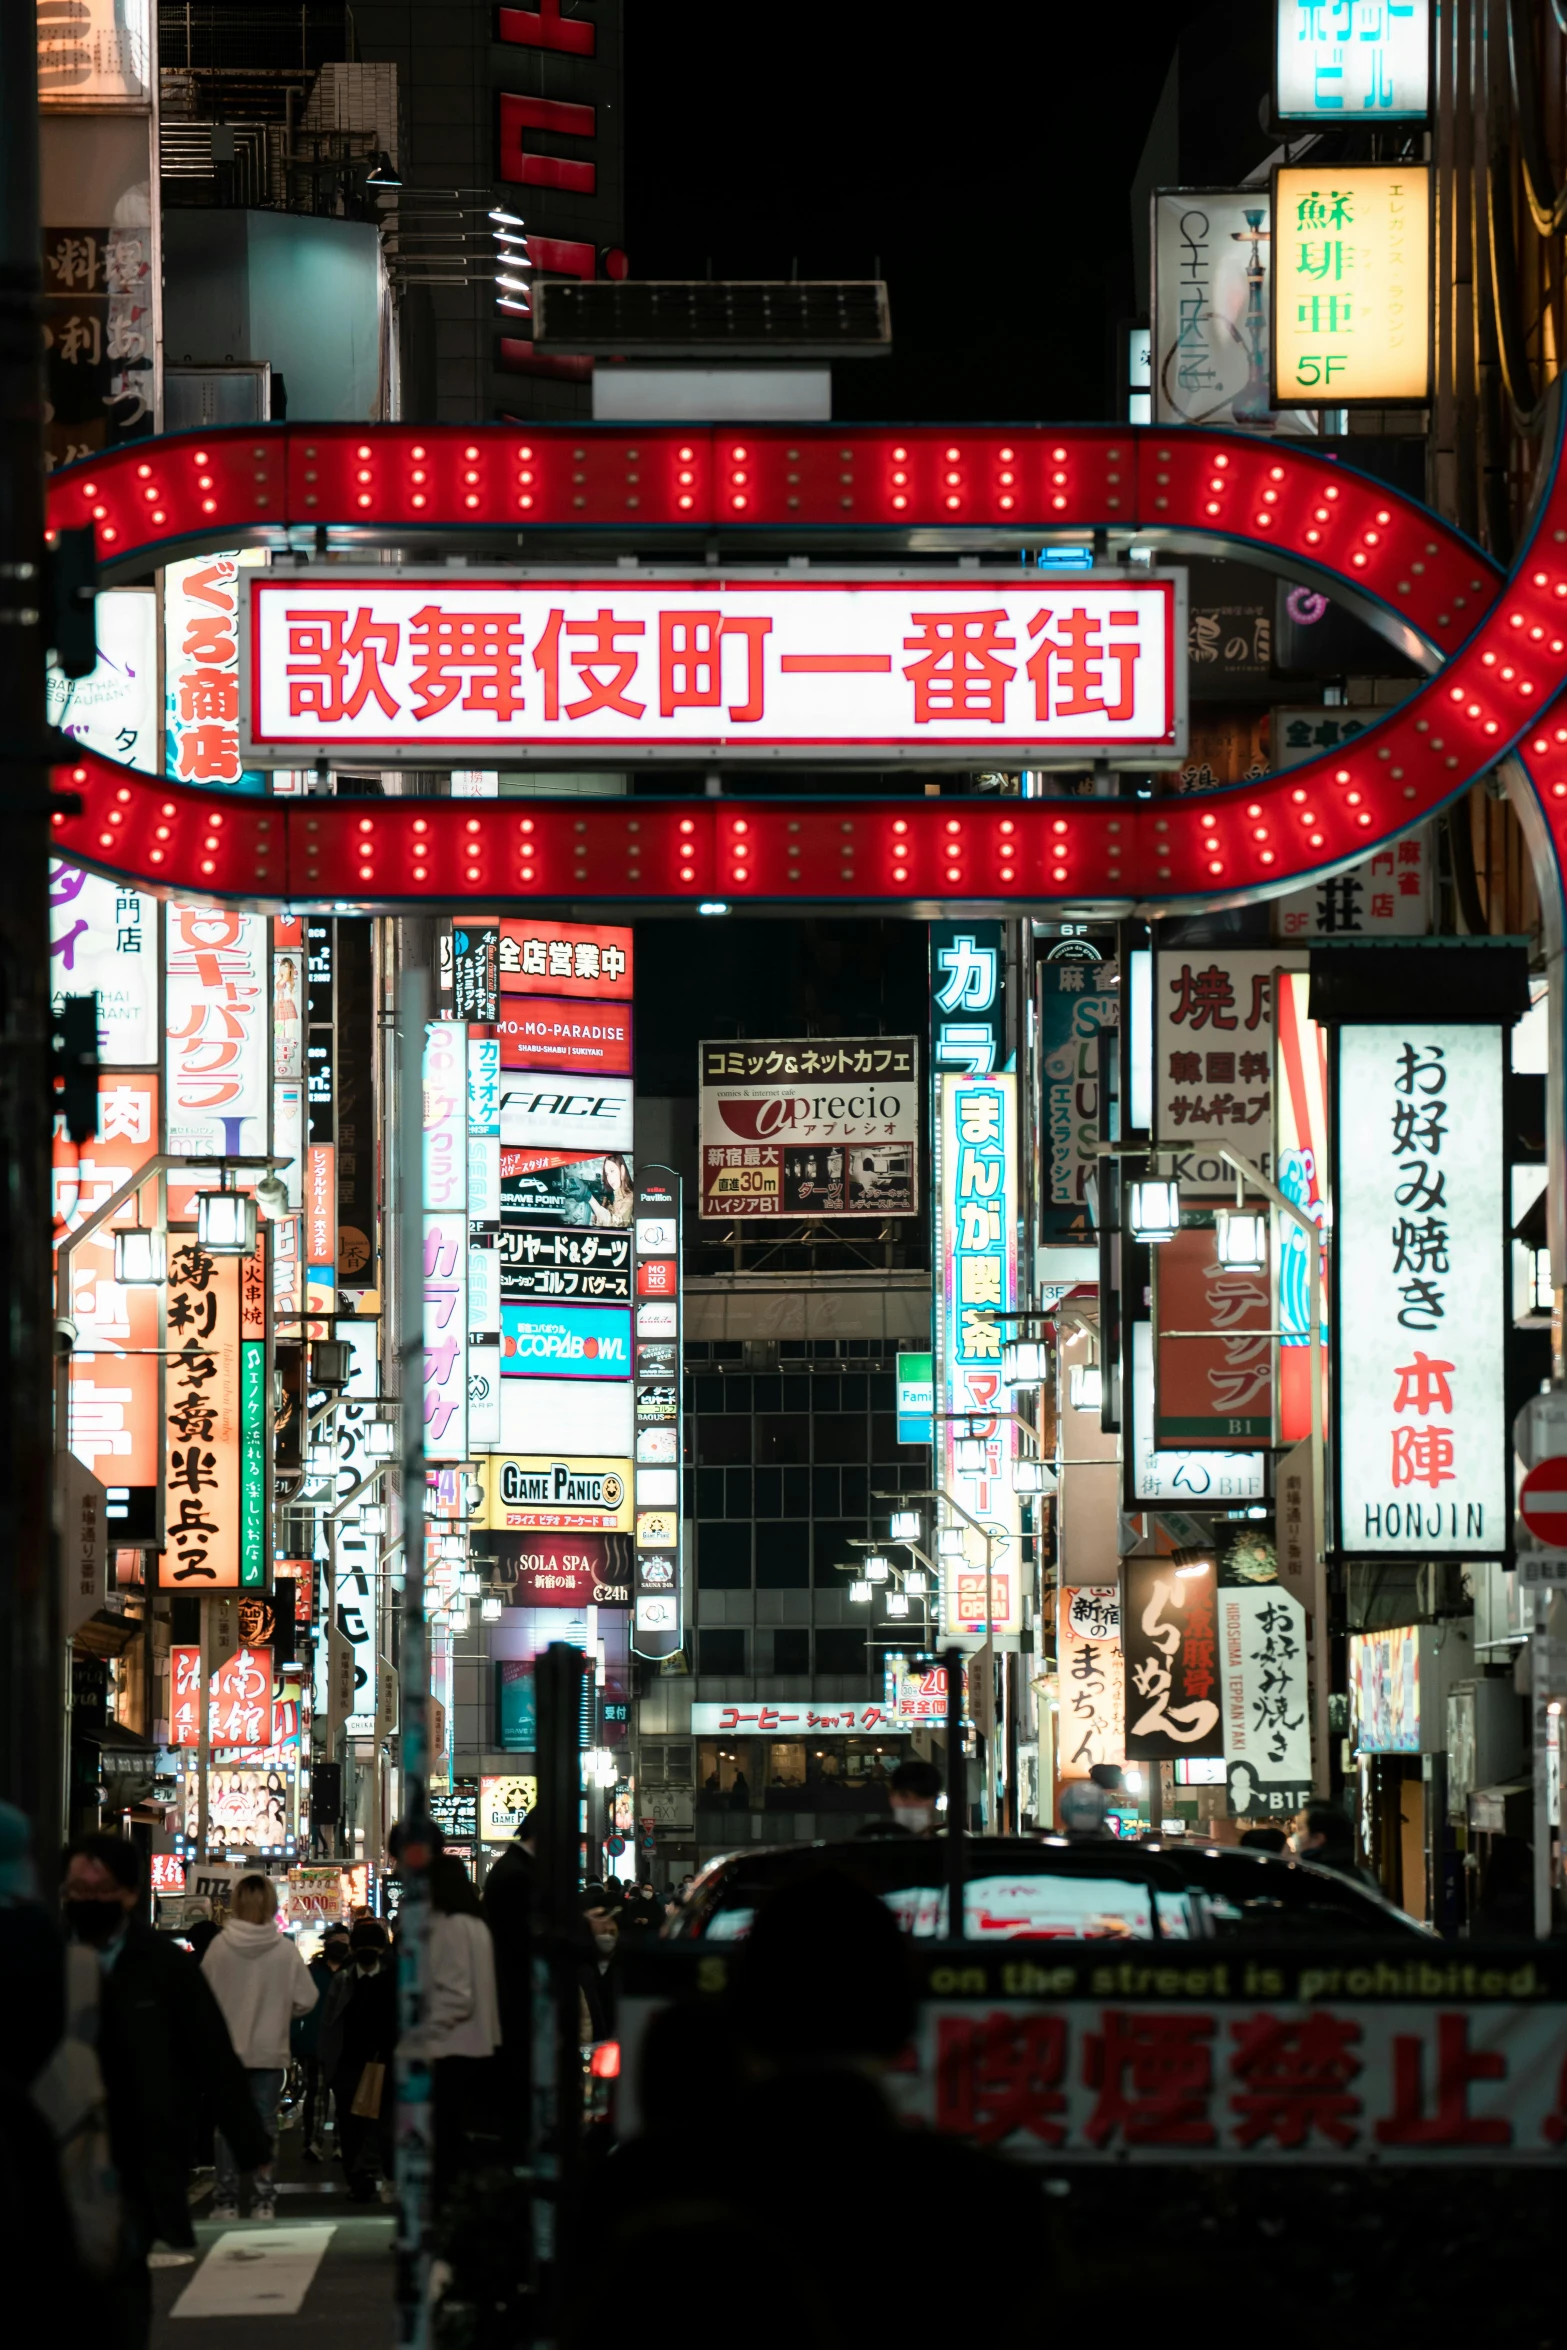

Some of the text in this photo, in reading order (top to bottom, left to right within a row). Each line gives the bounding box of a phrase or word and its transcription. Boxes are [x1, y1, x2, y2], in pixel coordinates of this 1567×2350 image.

[1314, 48, 1393, 108] ビル
[1294, 354, 1349, 386] 5F
[178, 561, 240, 779] ぐろ商店
[285, 605, 1140, 723] 歌舞伎町一番街
[1397, 839, 1421, 896] 麻雀
[1060, 924, 1088, 936] 6F
[1284, 912, 1309, 934] 3F
[482, 930, 497, 945] 4F
[499, 936, 626, 981] 全店営業中
[455, 957, 464, 1019] ダーツ・ビリヤード
[464, 957, 475, 1011] &コミック
[475, 944, 486, 1020] インターネット
[1059, 965, 1119, 992] 麻雀
[934, 934, 998, 1072] カラ
[496, 1020, 625, 1041] MO-MO-PARADISE
[517, 1044, 604, 1057] SHABU-SHABU SUKIYAKI
[708, 1049, 910, 1076] コミック&ネットカフェ
[479, 1041, 499, 1123] カラオケ
[752, 1089, 780, 1097] internet
[781, 1088, 796, 1096] cafe
[500, 1091, 627, 1118] FACE
[755, 1086, 901, 1136] aprecio
[803, 1122, 896, 1136] アプレシオ
[1053, 1085, 1071, 1201] エスラッシュ
[708, 1147, 779, 1167] 新宿最大
[469, 1142, 487, 1213] SEGA
[718, 1171, 776, 1192] 直進30m
[1390, 1041, 1450, 1332] お好み焼き
[500, 1193, 566, 1205] BRAVE POINT
[640, 1193, 672, 1202] Pavilion
[798, 1182, 843, 1199] ダーツ
[858, 1187, 910, 1198] インターネット
[313, 1149, 327, 1258] レンタルルーム ホステル
[708, 1197, 779, 1213] ハイジアB1
[469, 1221, 484, 1232] 2F
[956, 1090, 1004, 1363] まんが喫茶
[493, 1232, 629, 1267] ビリヤード&ダーツ
[648, 1264, 666, 1274] MO
[648, 1276, 666, 1286] MO
[469, 1253, 487, 1326] SEGA
[582, 1276, 629, 1296] バグース
[1045, 1287, 1065, 1299] 3F
[423, 1226, 460, 1441] カラオケ
[469, 1333, 484, 1344] 1F
[517, 1323, 567, 1335] 新宿コパボウル
[517, 1330, 627, 1361] COPABOWL
[902, 1391, 932, 1402] Fami
[1228, 1418, 1253, 1435] B1
[1390, 1349, 1456, 1490] 本陣
[503, 1465, 601, 1501] GAME PANIC
[507, 1513, 536, 1525] プライズ
[539, 1514, 561, 1526] ビデオ
[563, 1515, 600, 1527] アーケード
[1285, 1474, 1302, 1577] 劇場通り一番街
[1364, 1500, 1483, 1540] HONJIN
[519, 1554, 591, 1572] SOLA SPA
[534, 1574, 577, 1589] 新宿の湯
[604, 1585, 629, 1602] 24h
[961, 1578, 1007, 1598] 24h
[1072, 1596, 1120, 1626] 新宿
[1090, 1623, 1108, 1638] の
[1225, 1602, 1242, 1668] HIROSHIMA
[1250, 1600, 1306, 1763] お好み焼き
[604, 1706, 627, 1720] 受付
[1071, 1642, 1108, 1767] まっちゃん
[718, 1706, 856, 1730] コーヒー ショップ
[1269, 1790, 1311, 1810] B1F
[492, 1811, 515, 1824] GAME
[927, 1958, 1550, 2002] on the street is prohibited.
